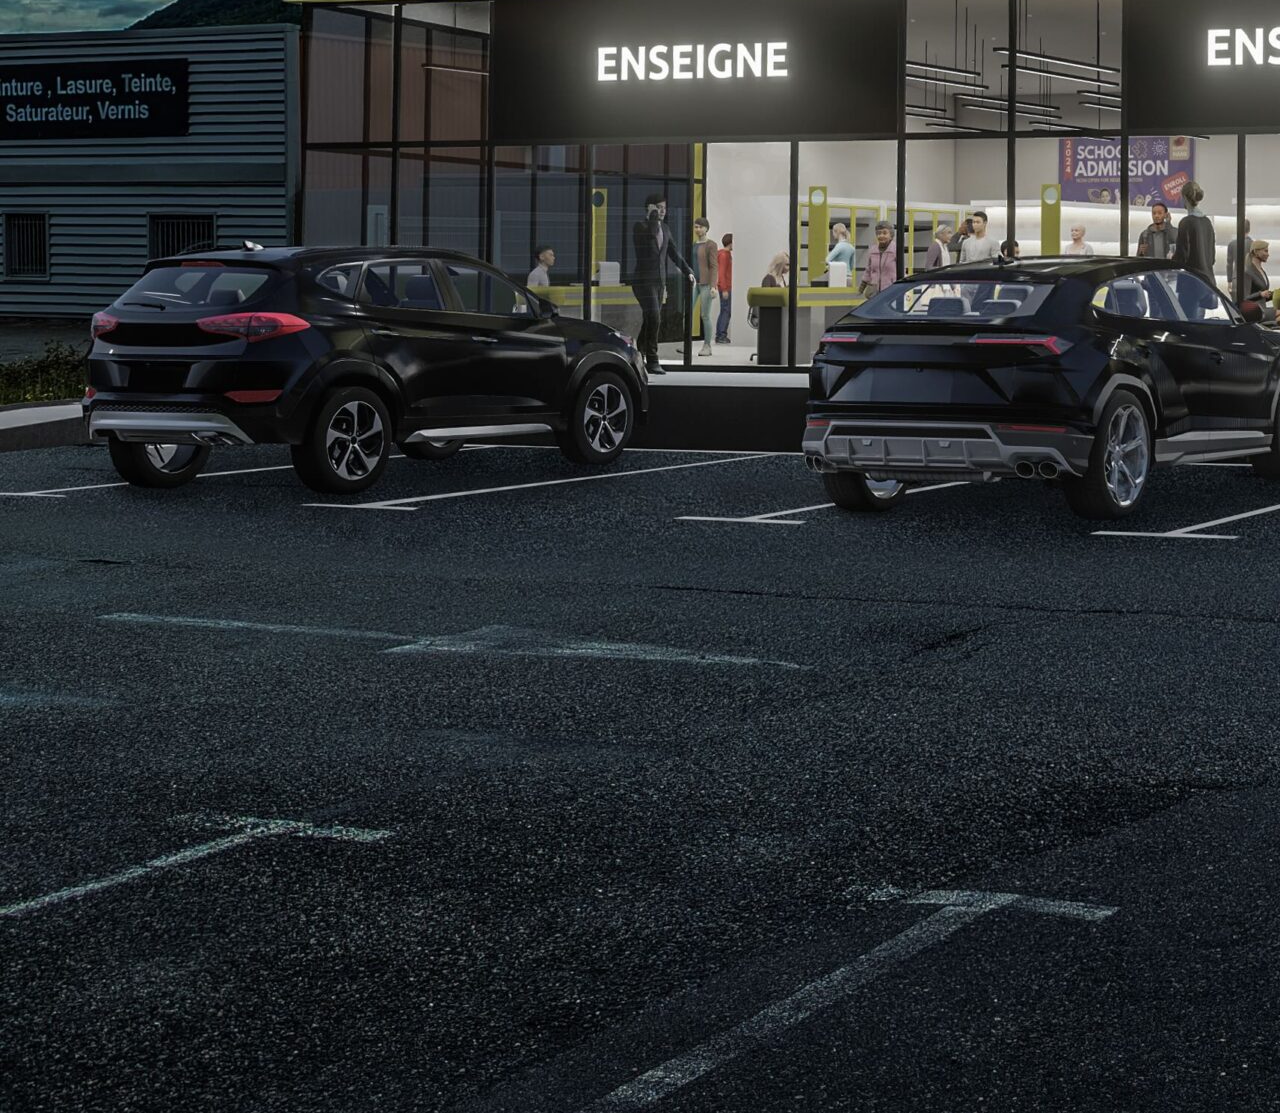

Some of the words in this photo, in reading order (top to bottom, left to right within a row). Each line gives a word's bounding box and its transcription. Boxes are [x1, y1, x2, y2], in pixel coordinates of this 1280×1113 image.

[598, 42, 788, 81] ENSEIGNE
[57, 75, 117, 97] Lasure,
[121, 72, 176, 95] Teinte,
[6, 101, 93, 123] Saturateur,
[97, 99, 149, 119] Vernis
